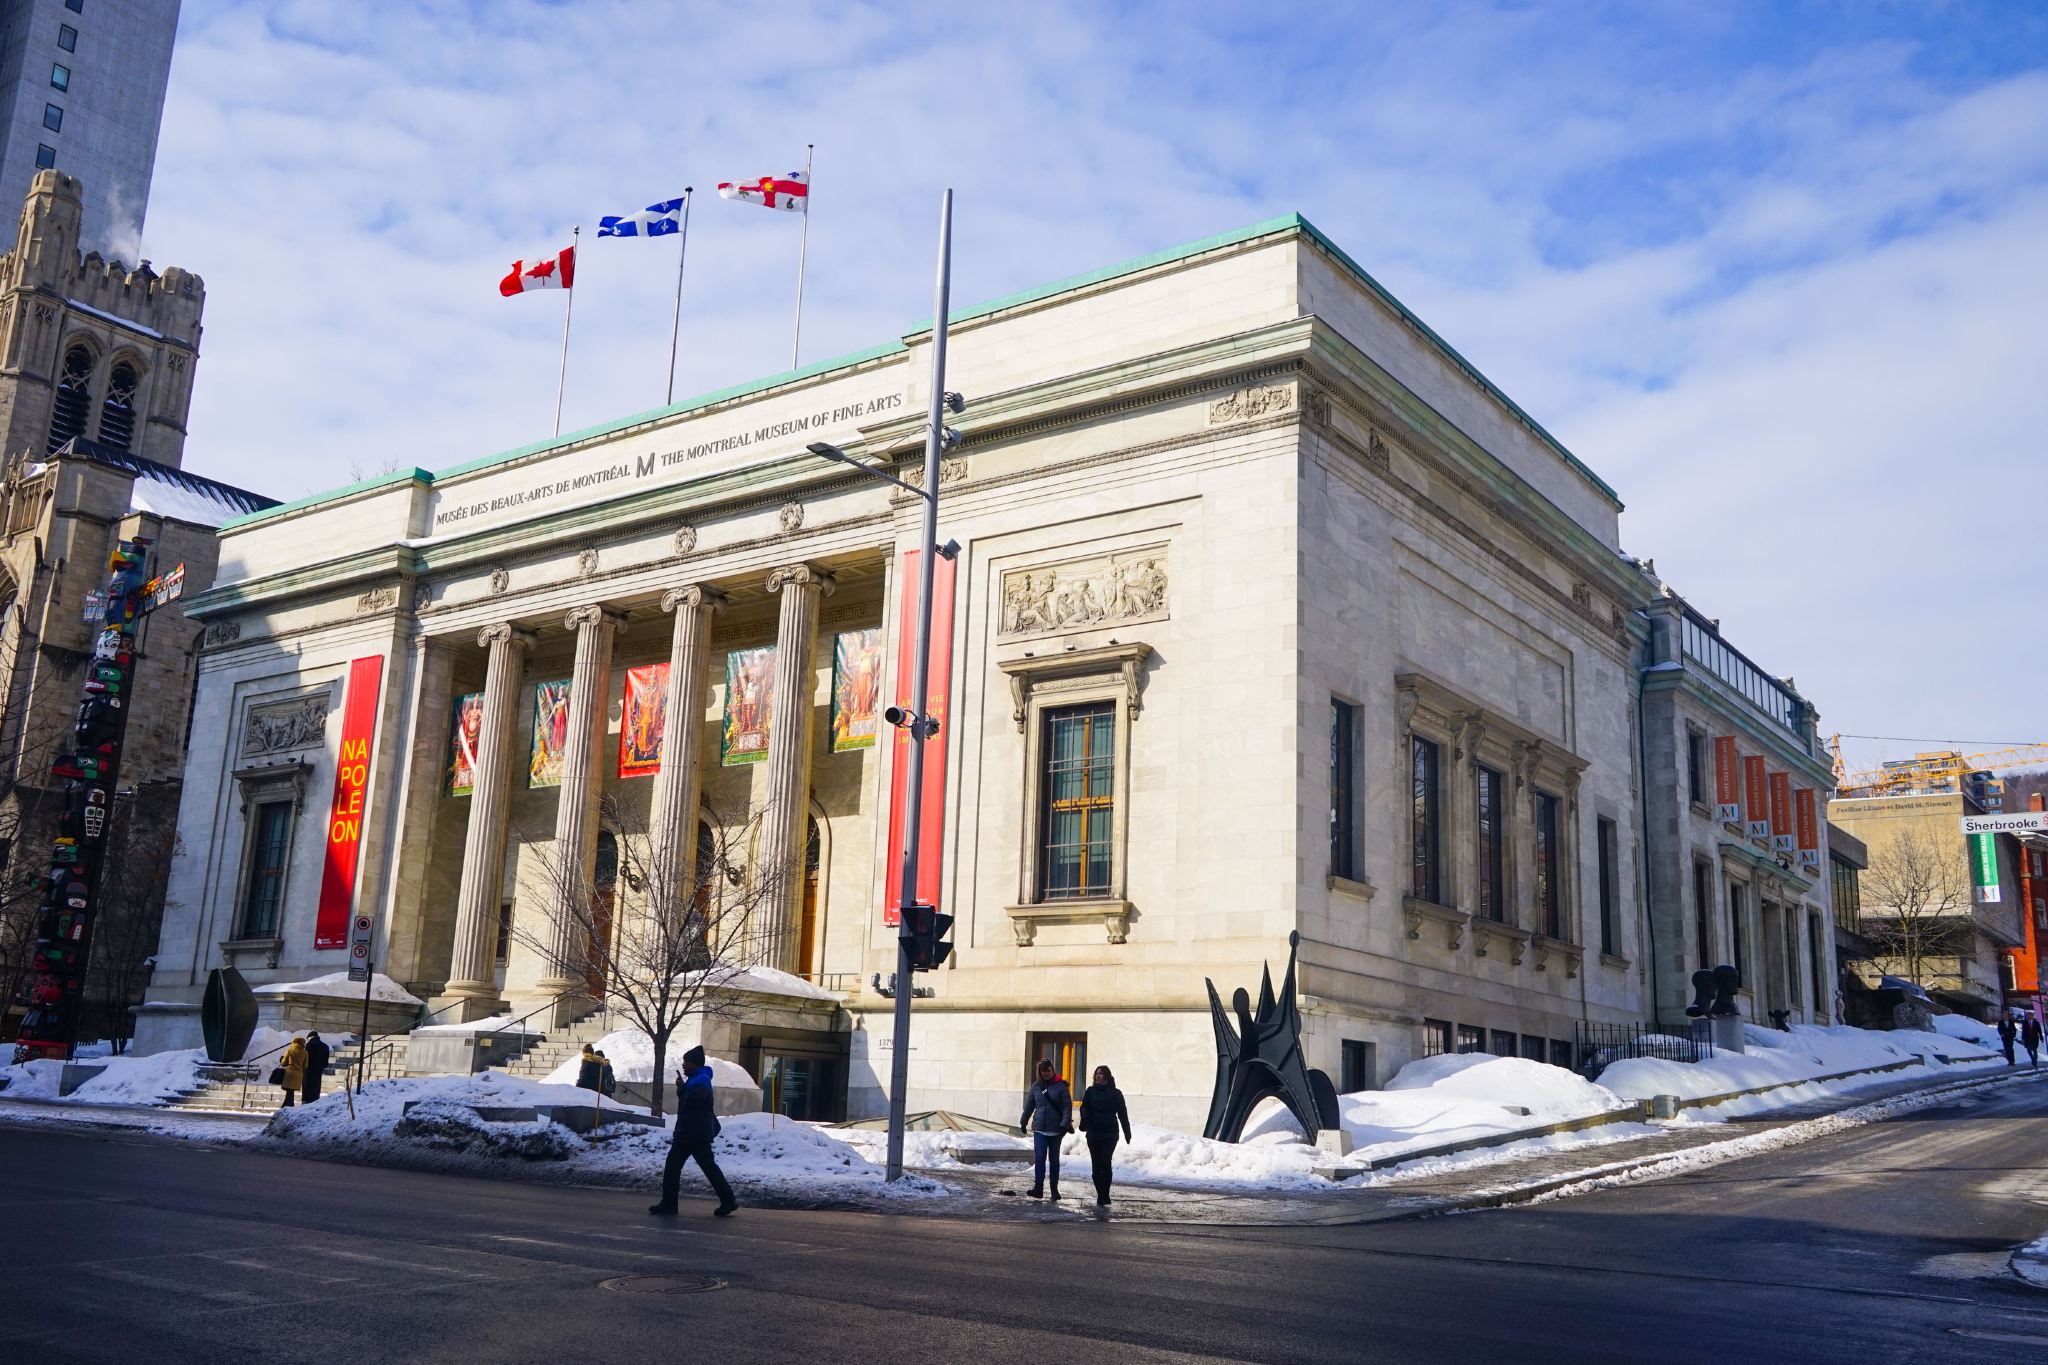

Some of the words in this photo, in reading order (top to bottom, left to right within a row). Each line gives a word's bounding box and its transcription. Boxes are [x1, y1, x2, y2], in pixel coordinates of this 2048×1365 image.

[661, 449, 685, 467] THE
[686, 433, 752, 461] MONTREAL
[754, 417, 809, 443] MUSEUM
[811, 411, 830, 429] OF
[832, 403, 863, 422] FINE
[866, 392, 901, 413] ARTS
[635, 451, 656, 479] M
[436, 506, 469, 526] MUSÉE
[470, 500, 490, 517] DES
[491, 484, 554, 511] BEAUX-ARTS
[556, 479, 570, 495] DE
[572, 464, 631, 489] MONTRÉAL
[1966, 819, 2038, 832] Sherbrooke
